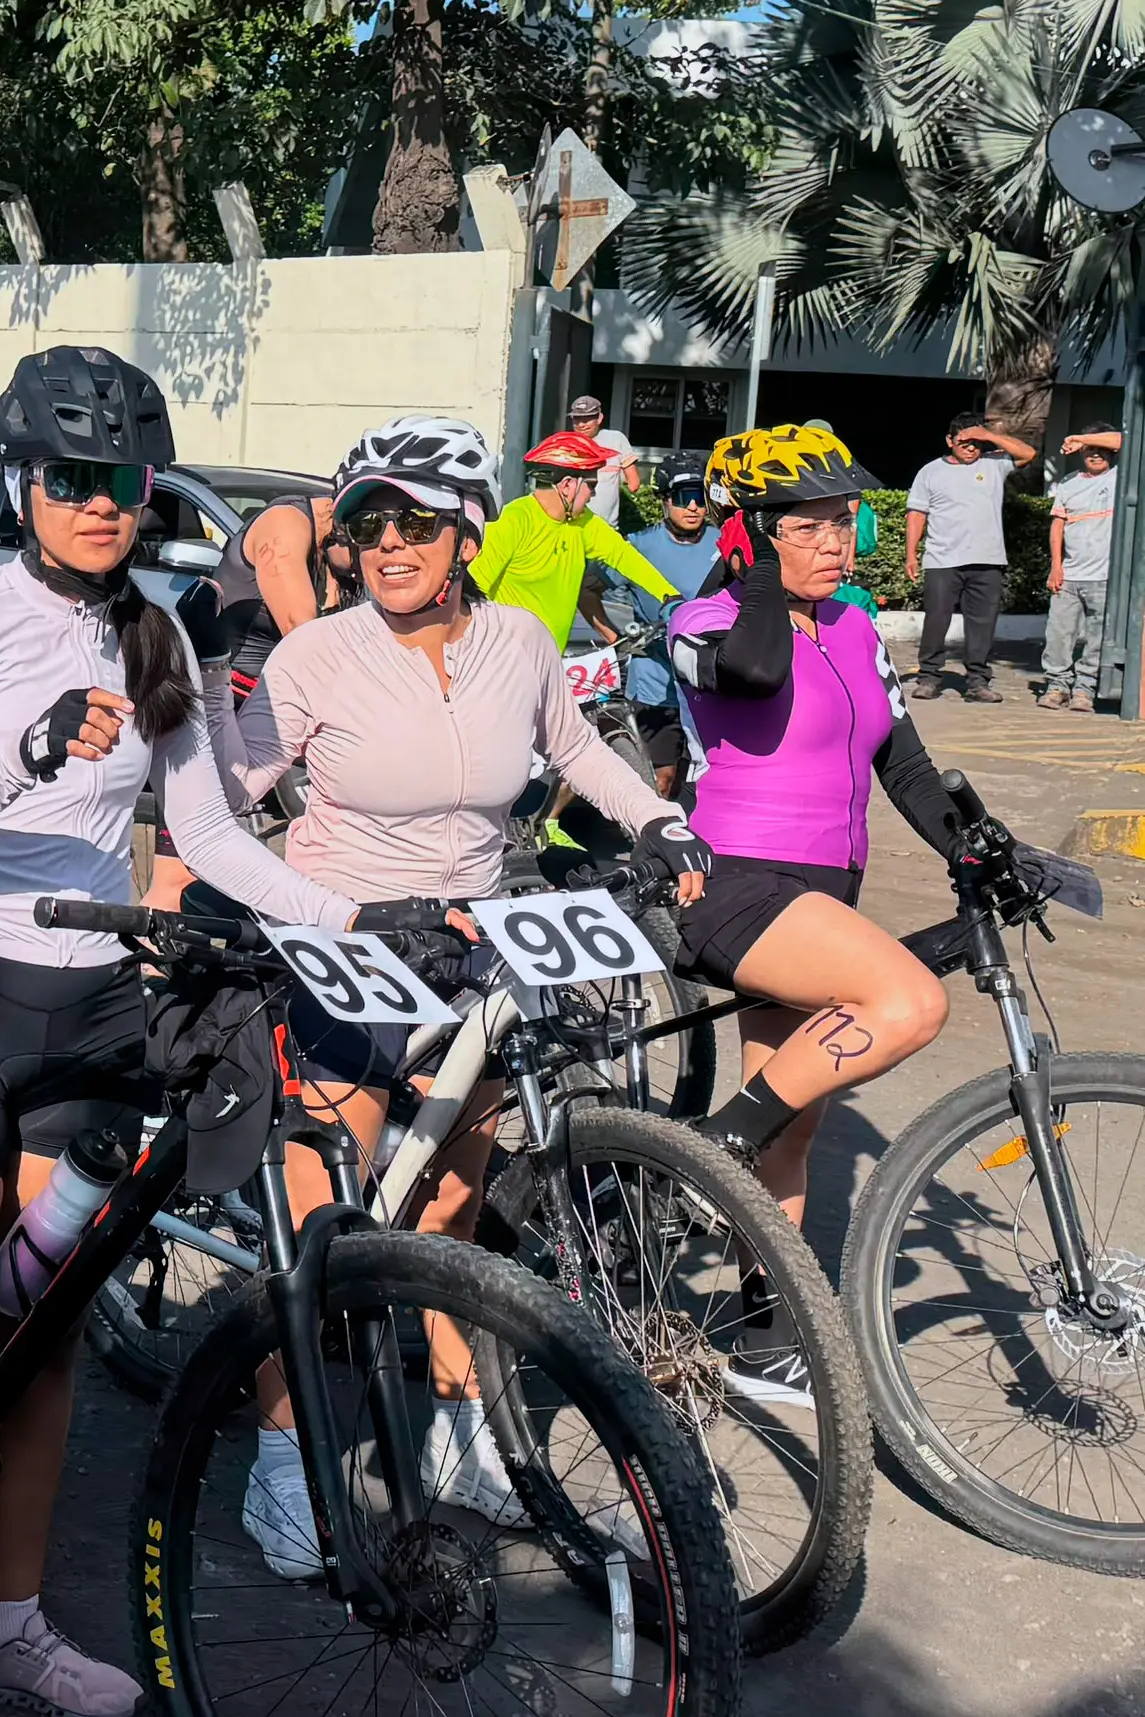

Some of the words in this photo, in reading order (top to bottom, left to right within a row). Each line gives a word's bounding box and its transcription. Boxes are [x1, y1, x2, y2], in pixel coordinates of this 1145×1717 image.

[565, 657, 617, 697] 24
[279, 939, 418, 1014] 95
[503, 904, 636, 979] 96
[804, 1004, 874, 1072] 172
[144, 1517, 176, 1689] MAXXIS
